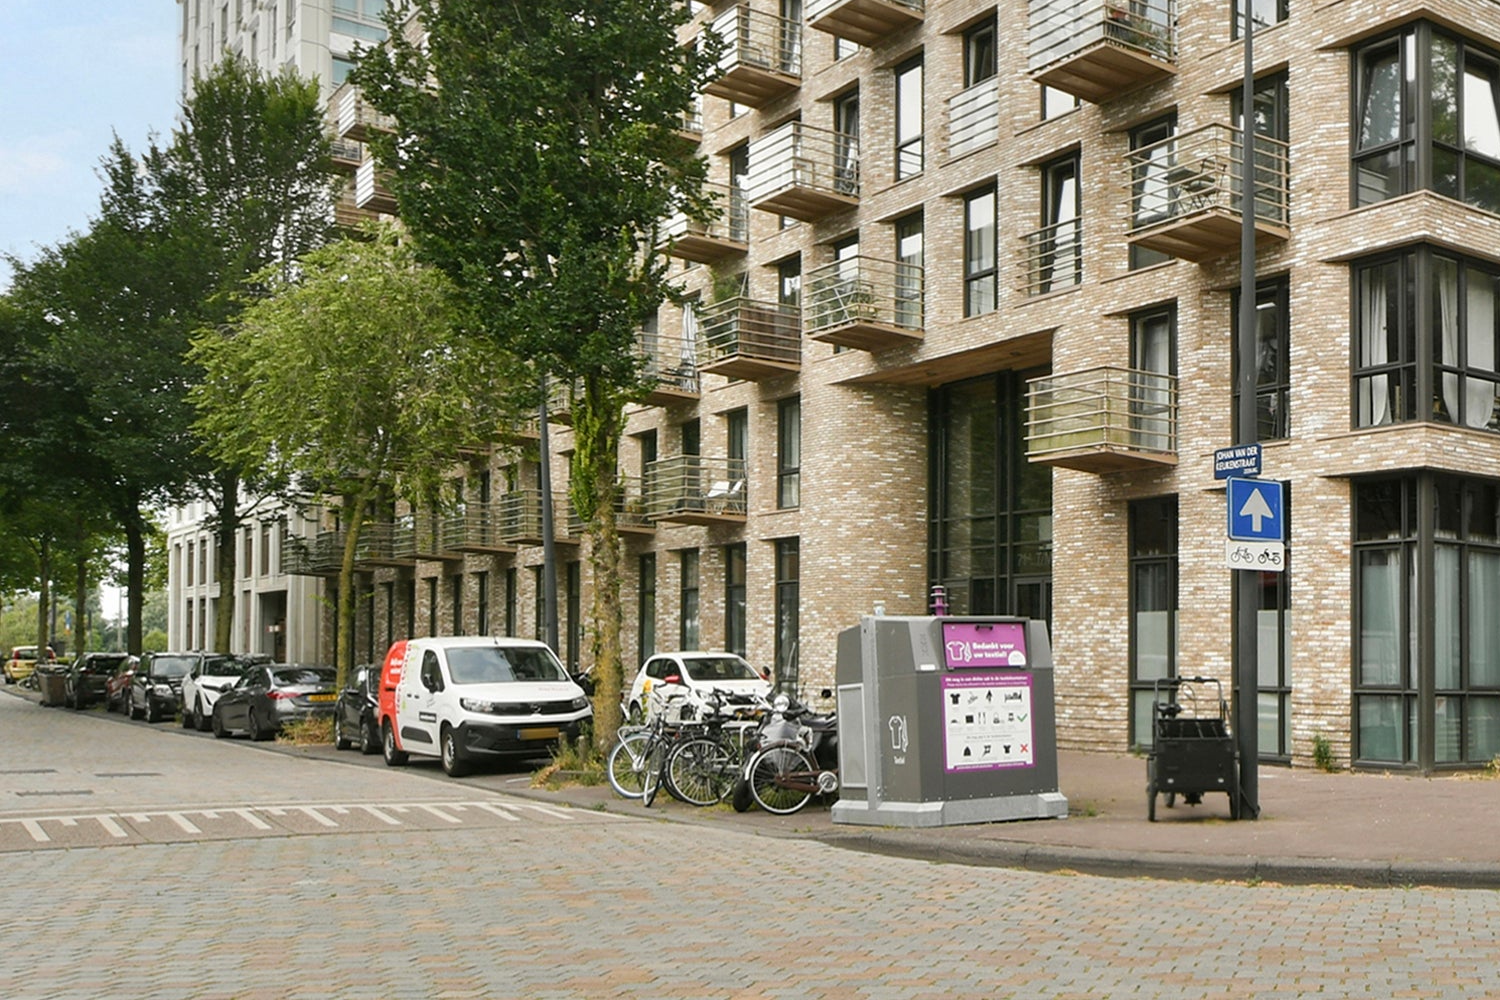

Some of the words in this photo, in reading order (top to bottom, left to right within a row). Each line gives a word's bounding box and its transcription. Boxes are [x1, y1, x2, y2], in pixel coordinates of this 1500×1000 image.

[1216, 450, 1234, 462] JOHAN
[1235, 448, 1246, 458] VAN
[1247, 446, 1258, 456] DER
[972, 642, 999, 650] Bedankt
